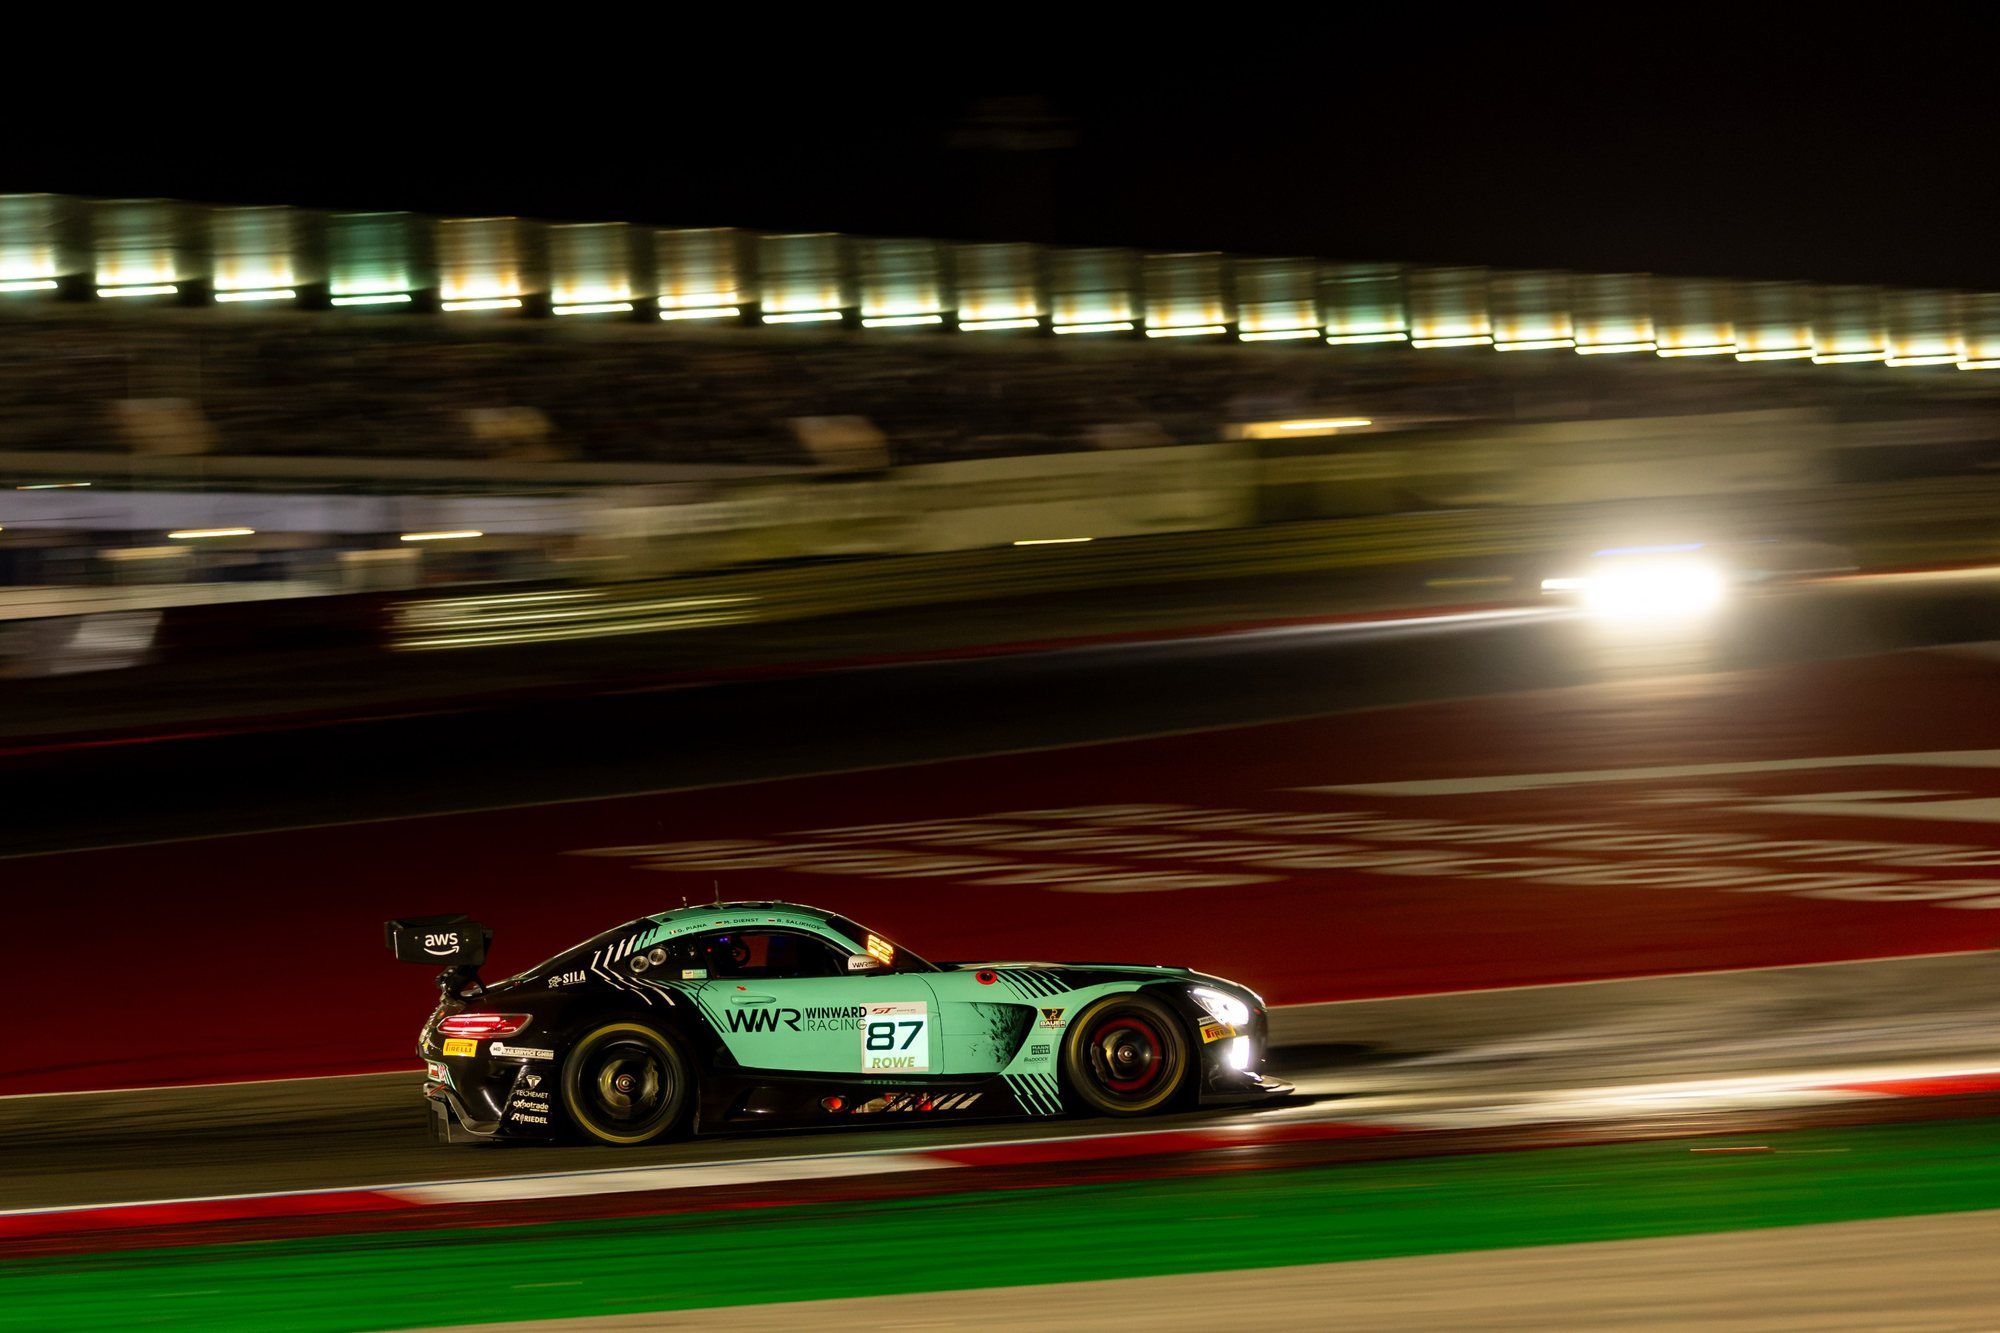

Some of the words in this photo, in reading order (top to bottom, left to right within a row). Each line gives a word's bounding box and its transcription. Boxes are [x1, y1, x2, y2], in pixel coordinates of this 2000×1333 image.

[686, 923, 707, 931] PIANA
[425, 932, 458, 947] aws
[563, 970, 586, 984] SILA
[805, 1006, 867, 1019] WINWARD
[807, 1019, 867, 1032] RACING
[866, 1021, 924, 1051] 87
[446, 1042, 473, 1053] PIRELLI
[872, 1056, 915, 1069] ROWE
[516, 1089, 549, 1099] TECHEMET
[524, 1115, 548, 1124] RIEDEL
